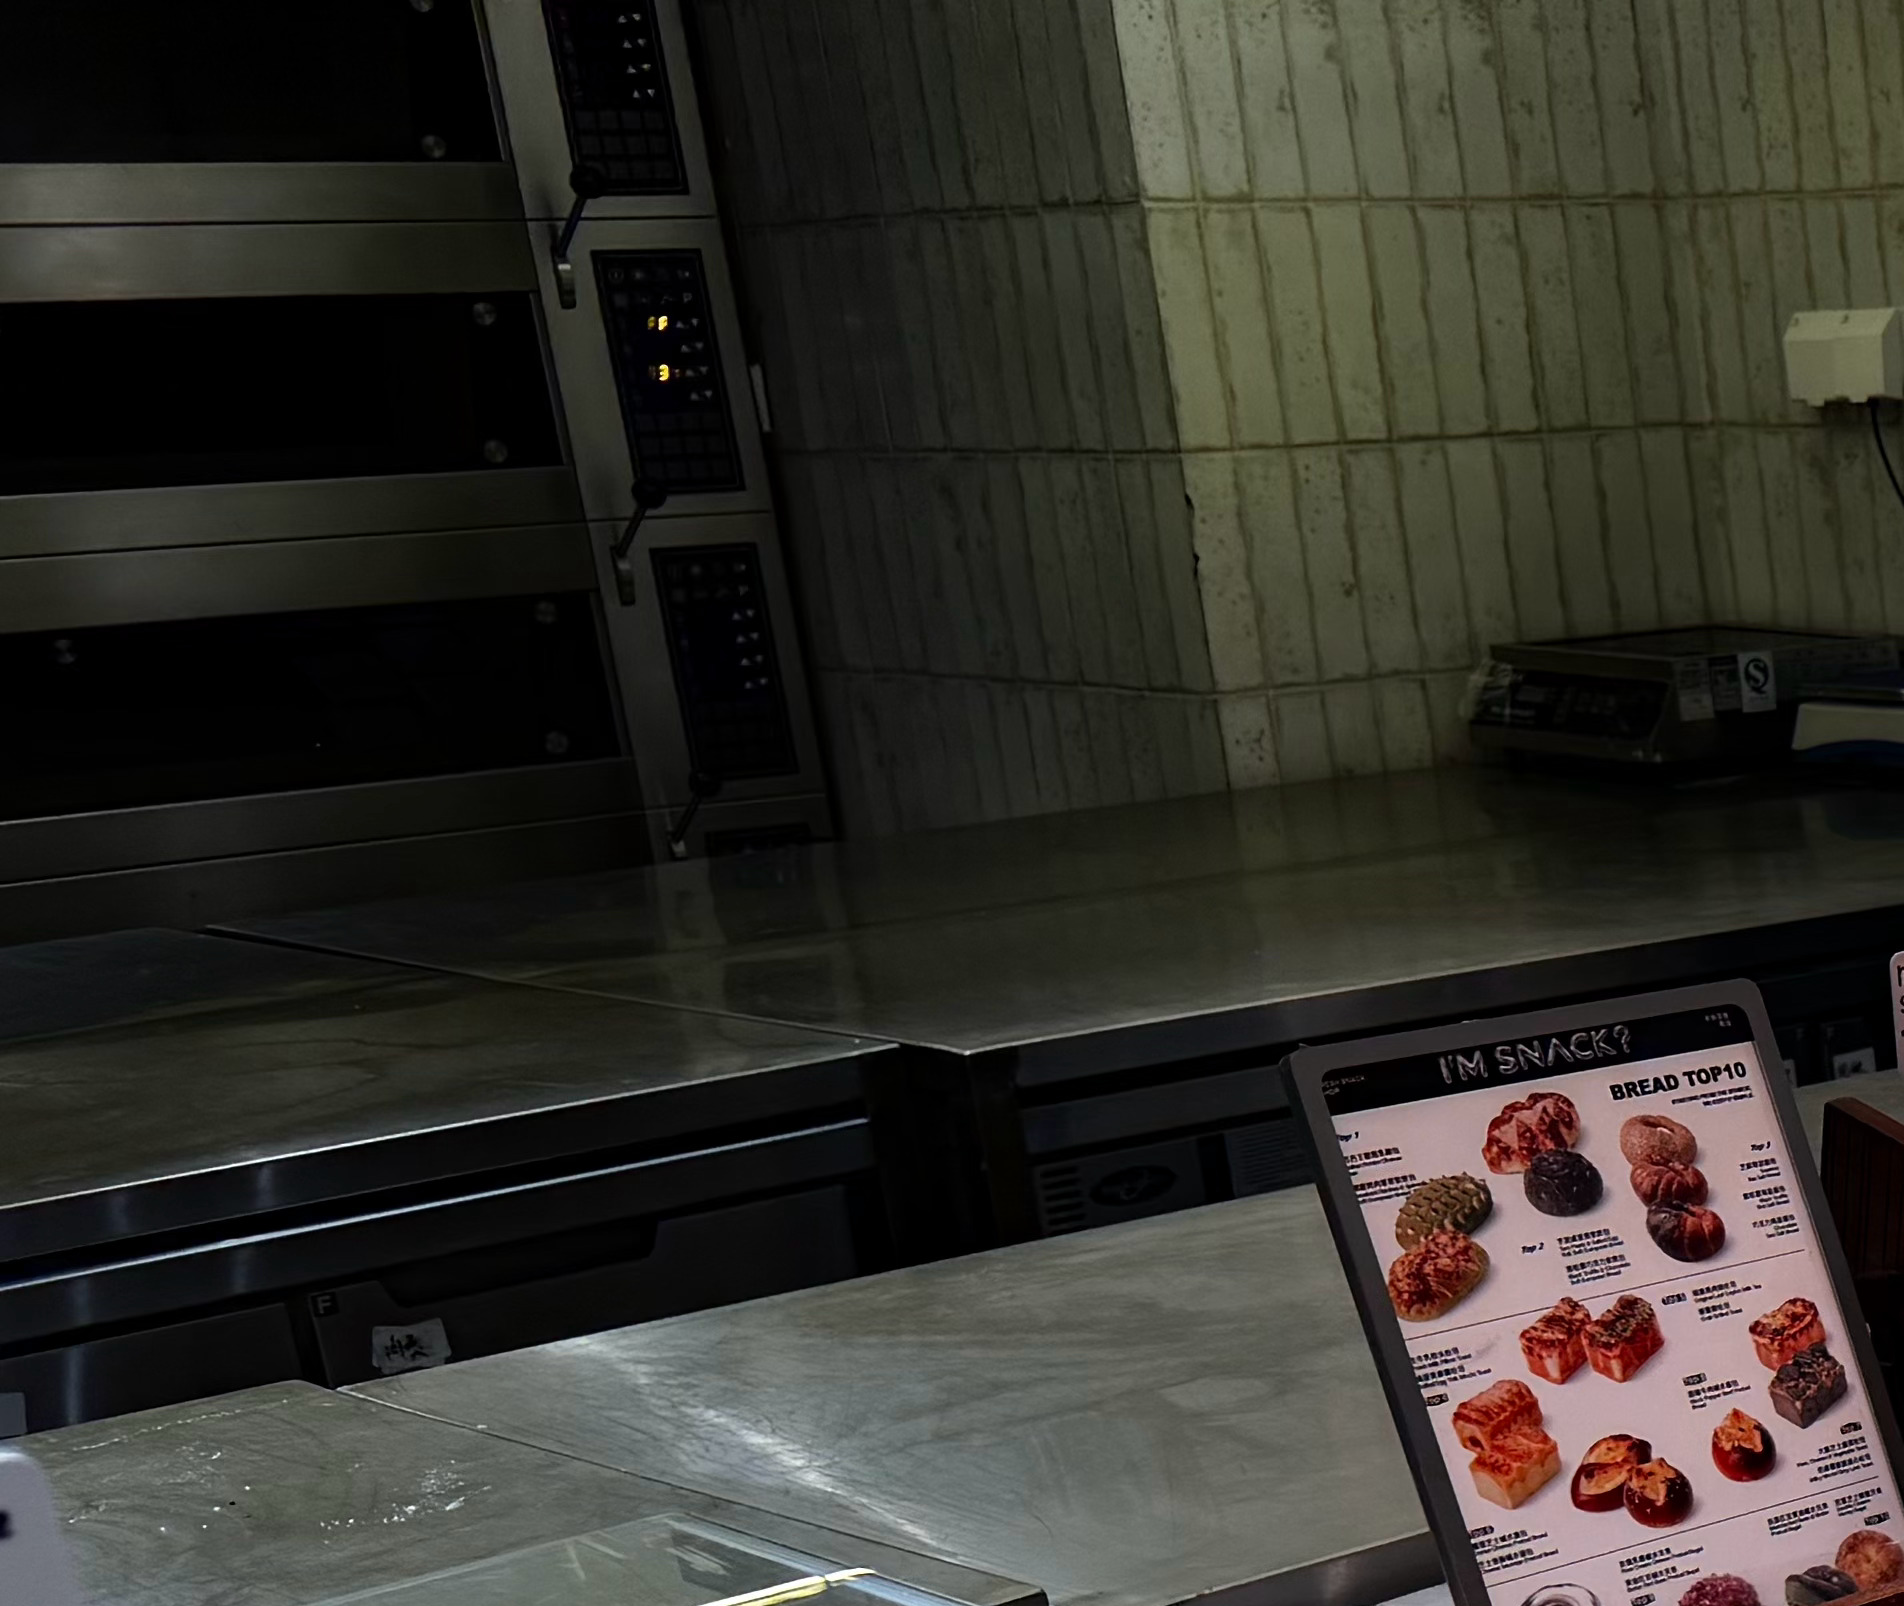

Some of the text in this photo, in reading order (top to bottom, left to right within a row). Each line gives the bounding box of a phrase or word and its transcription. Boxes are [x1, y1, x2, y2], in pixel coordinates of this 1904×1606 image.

[1438, 1024, 1633, 1084] I'M SNACK?
[1609, 1073, 1680, 1101] BREAD
[1682, 1061, 1747, 1087] TOP10
